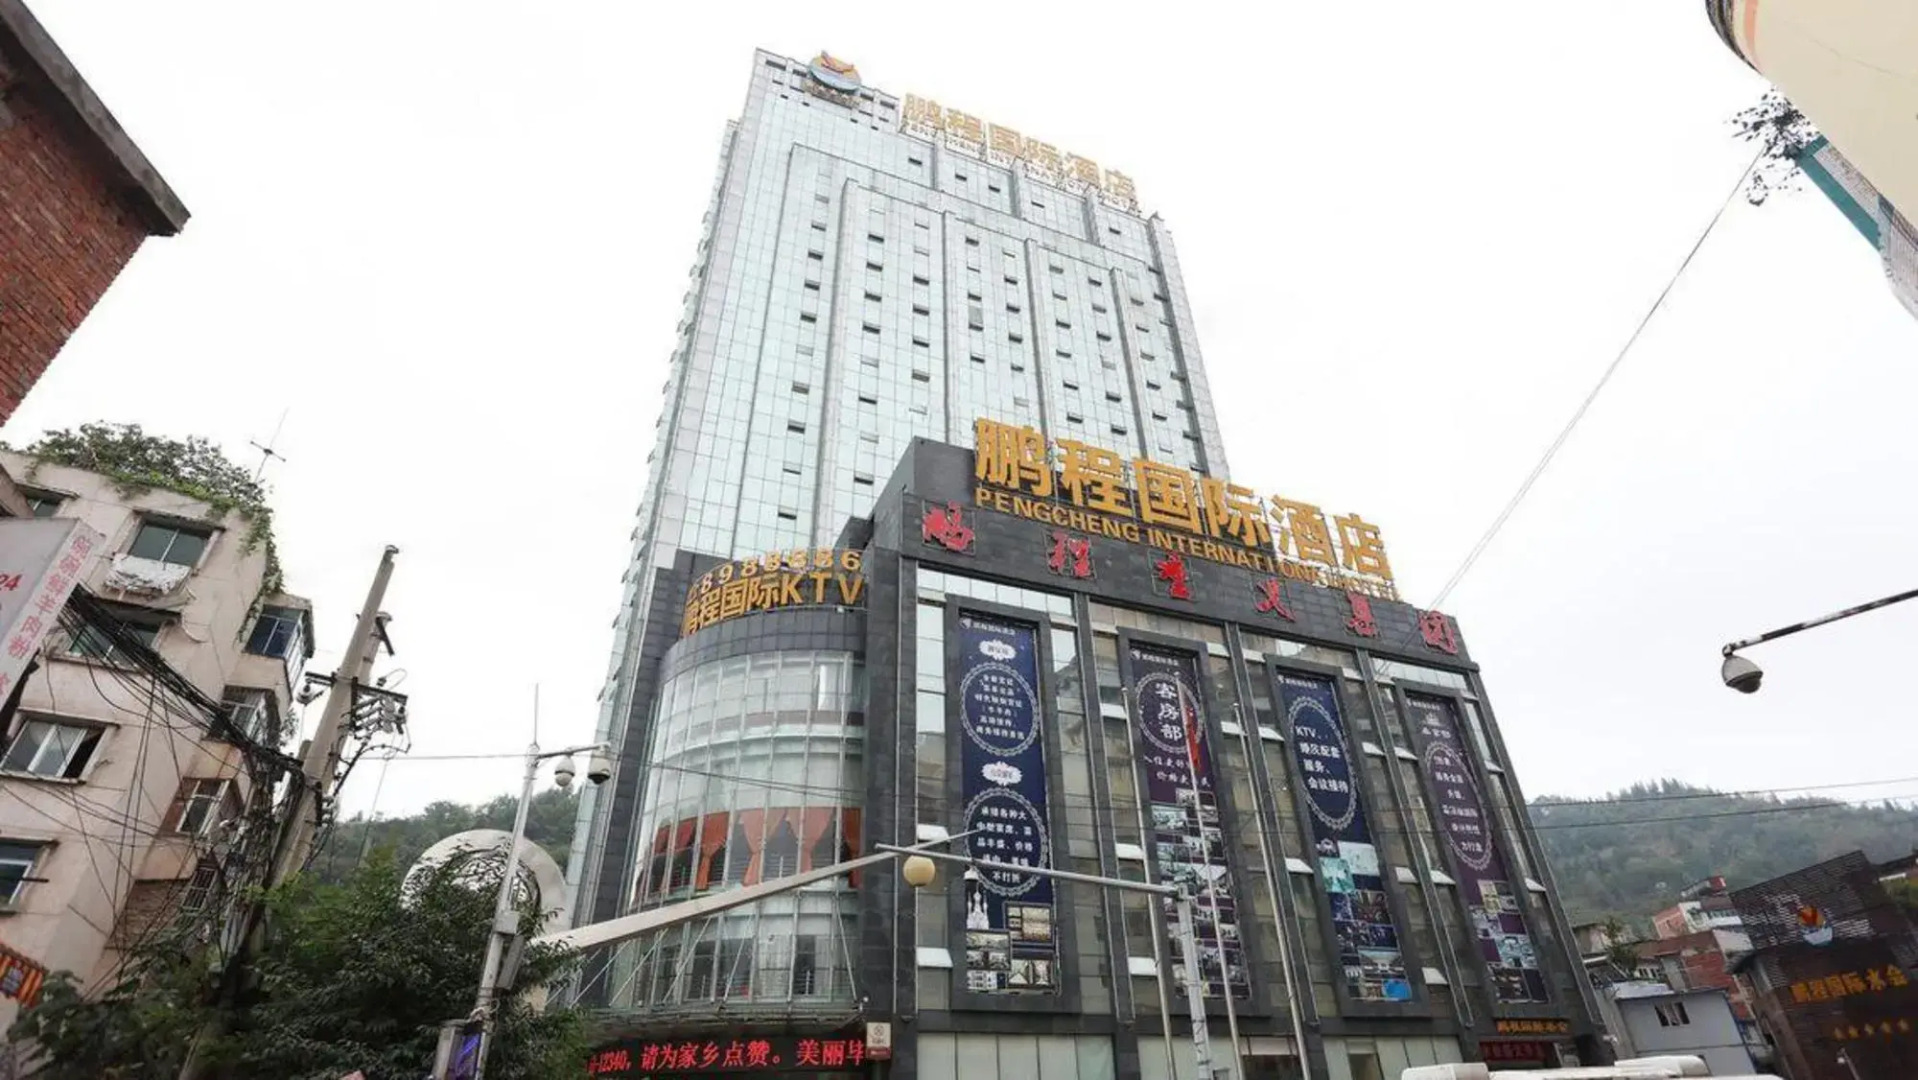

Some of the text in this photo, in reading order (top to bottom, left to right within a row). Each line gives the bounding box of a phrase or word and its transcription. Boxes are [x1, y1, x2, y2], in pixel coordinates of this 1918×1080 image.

[975, 417, 1392, 580] 鹏程国际酒店
[975, 487, 1139, 543] PENGCHENG
[1155, 682, 1183, 741] 客房部
[1308, 777, 1349, 794] 会议接待
